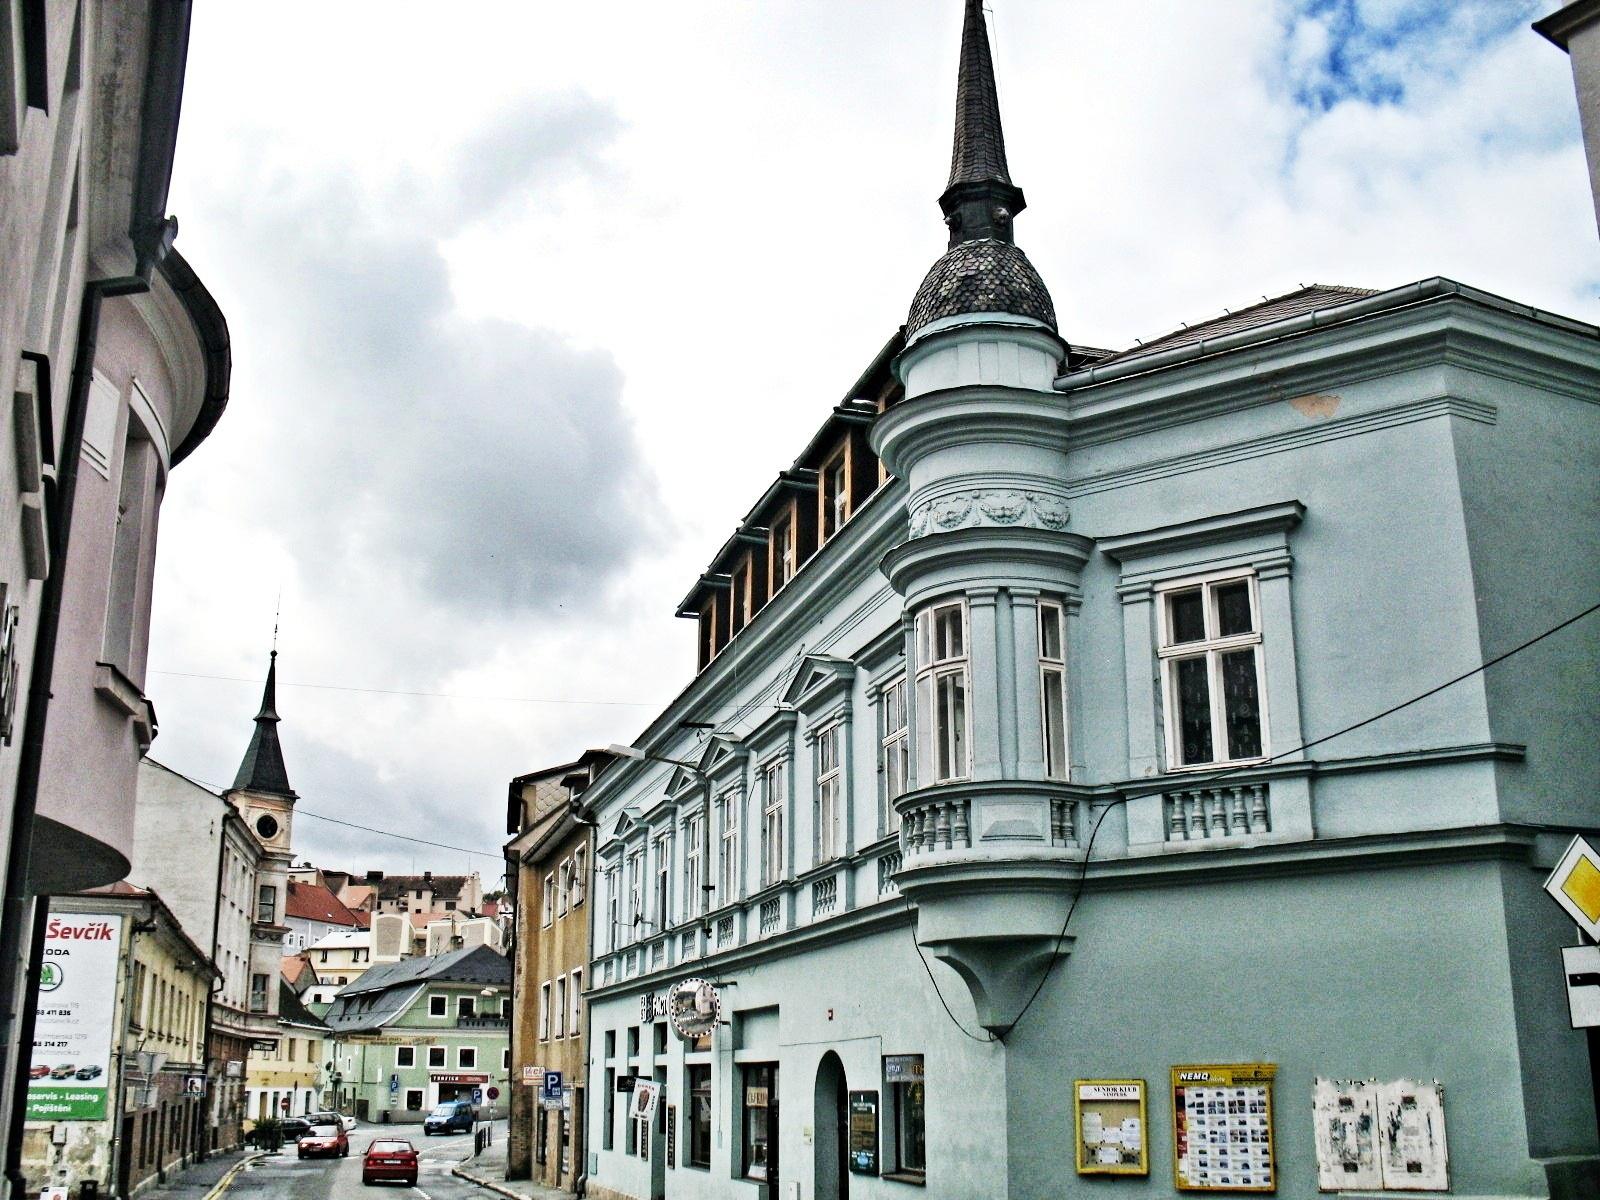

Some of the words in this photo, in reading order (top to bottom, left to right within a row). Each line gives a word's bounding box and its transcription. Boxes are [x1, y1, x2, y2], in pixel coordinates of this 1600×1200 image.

[46, 919, 114, 940] Ševčík
[42, 948, 70, 956] ODA
[1179, 1072, 1209, 1081] NEMO
[547, 1075, 559, 1090] P
[65, 1092, 99, 1103] Leasing
[473, 1090, 480, 1099] P
